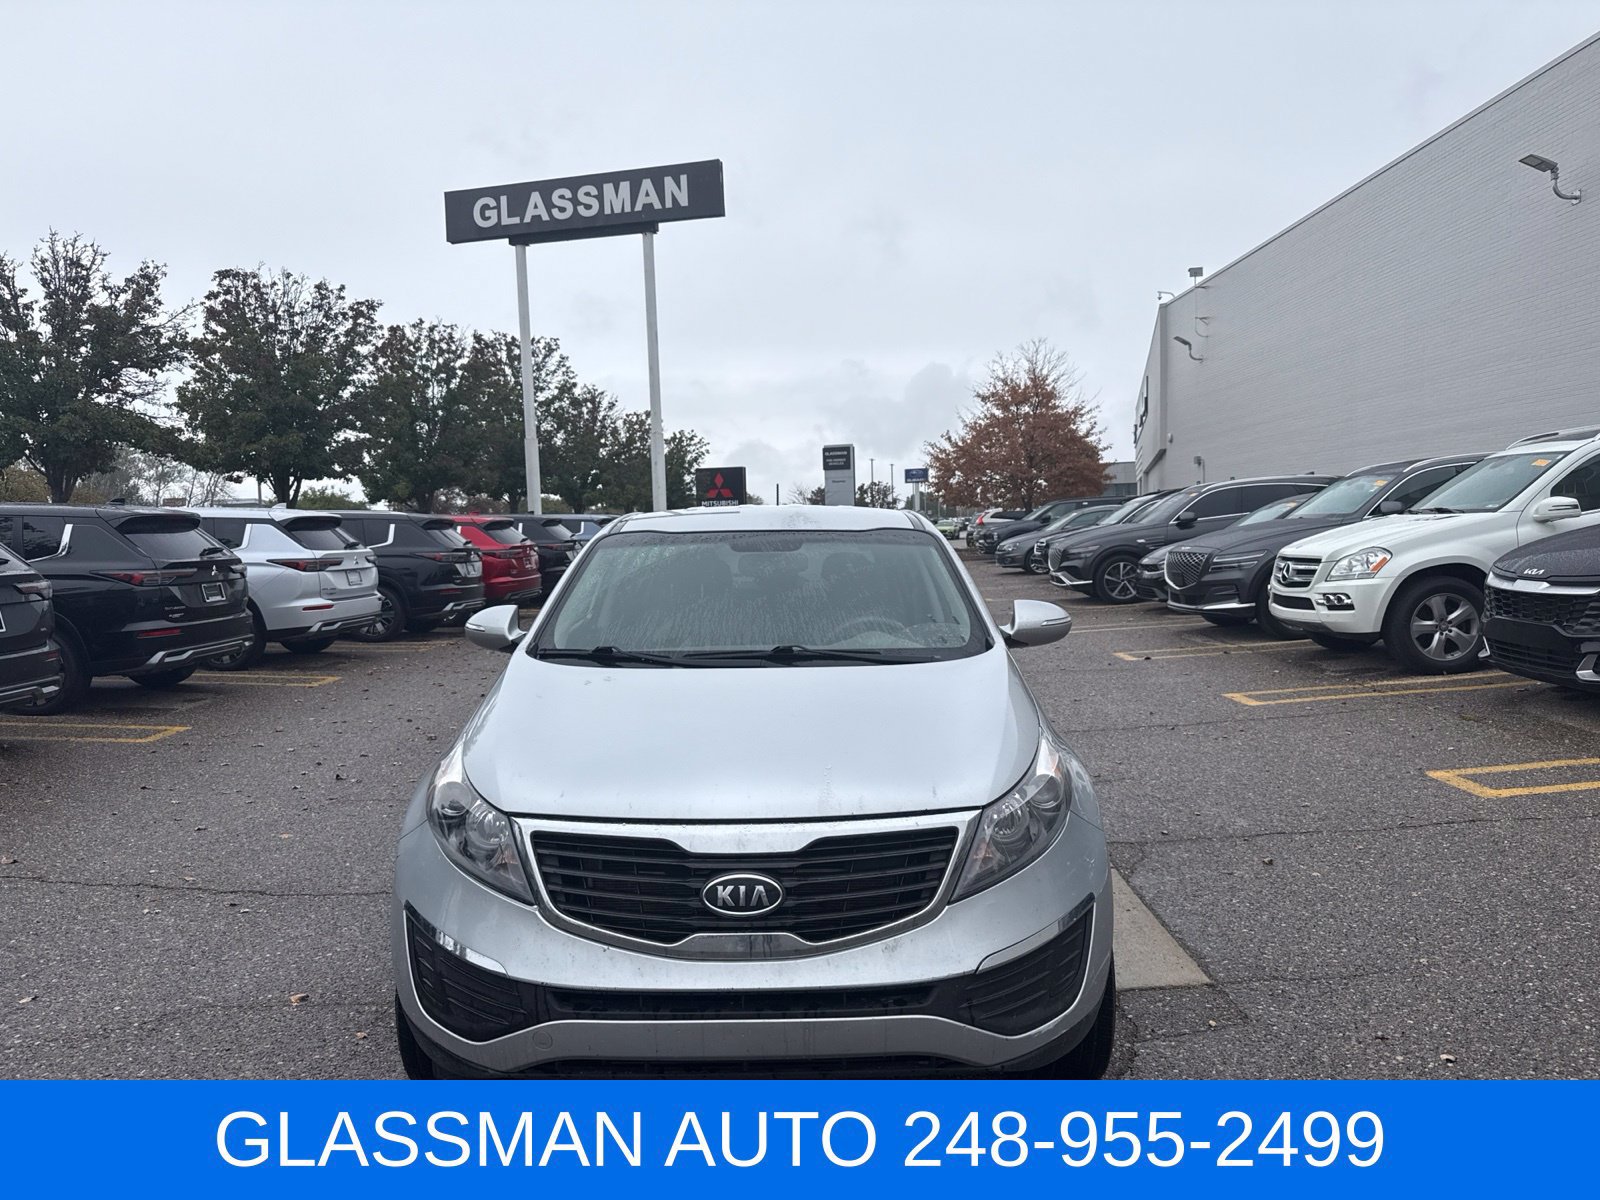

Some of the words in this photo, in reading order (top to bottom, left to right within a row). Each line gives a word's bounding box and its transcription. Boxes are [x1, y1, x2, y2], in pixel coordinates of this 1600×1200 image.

[472, 174, 689, 228] GLASSMAN
[701, 499, 739, 507] MITSUBISHI
[716, 885, 770, 907] KIA
